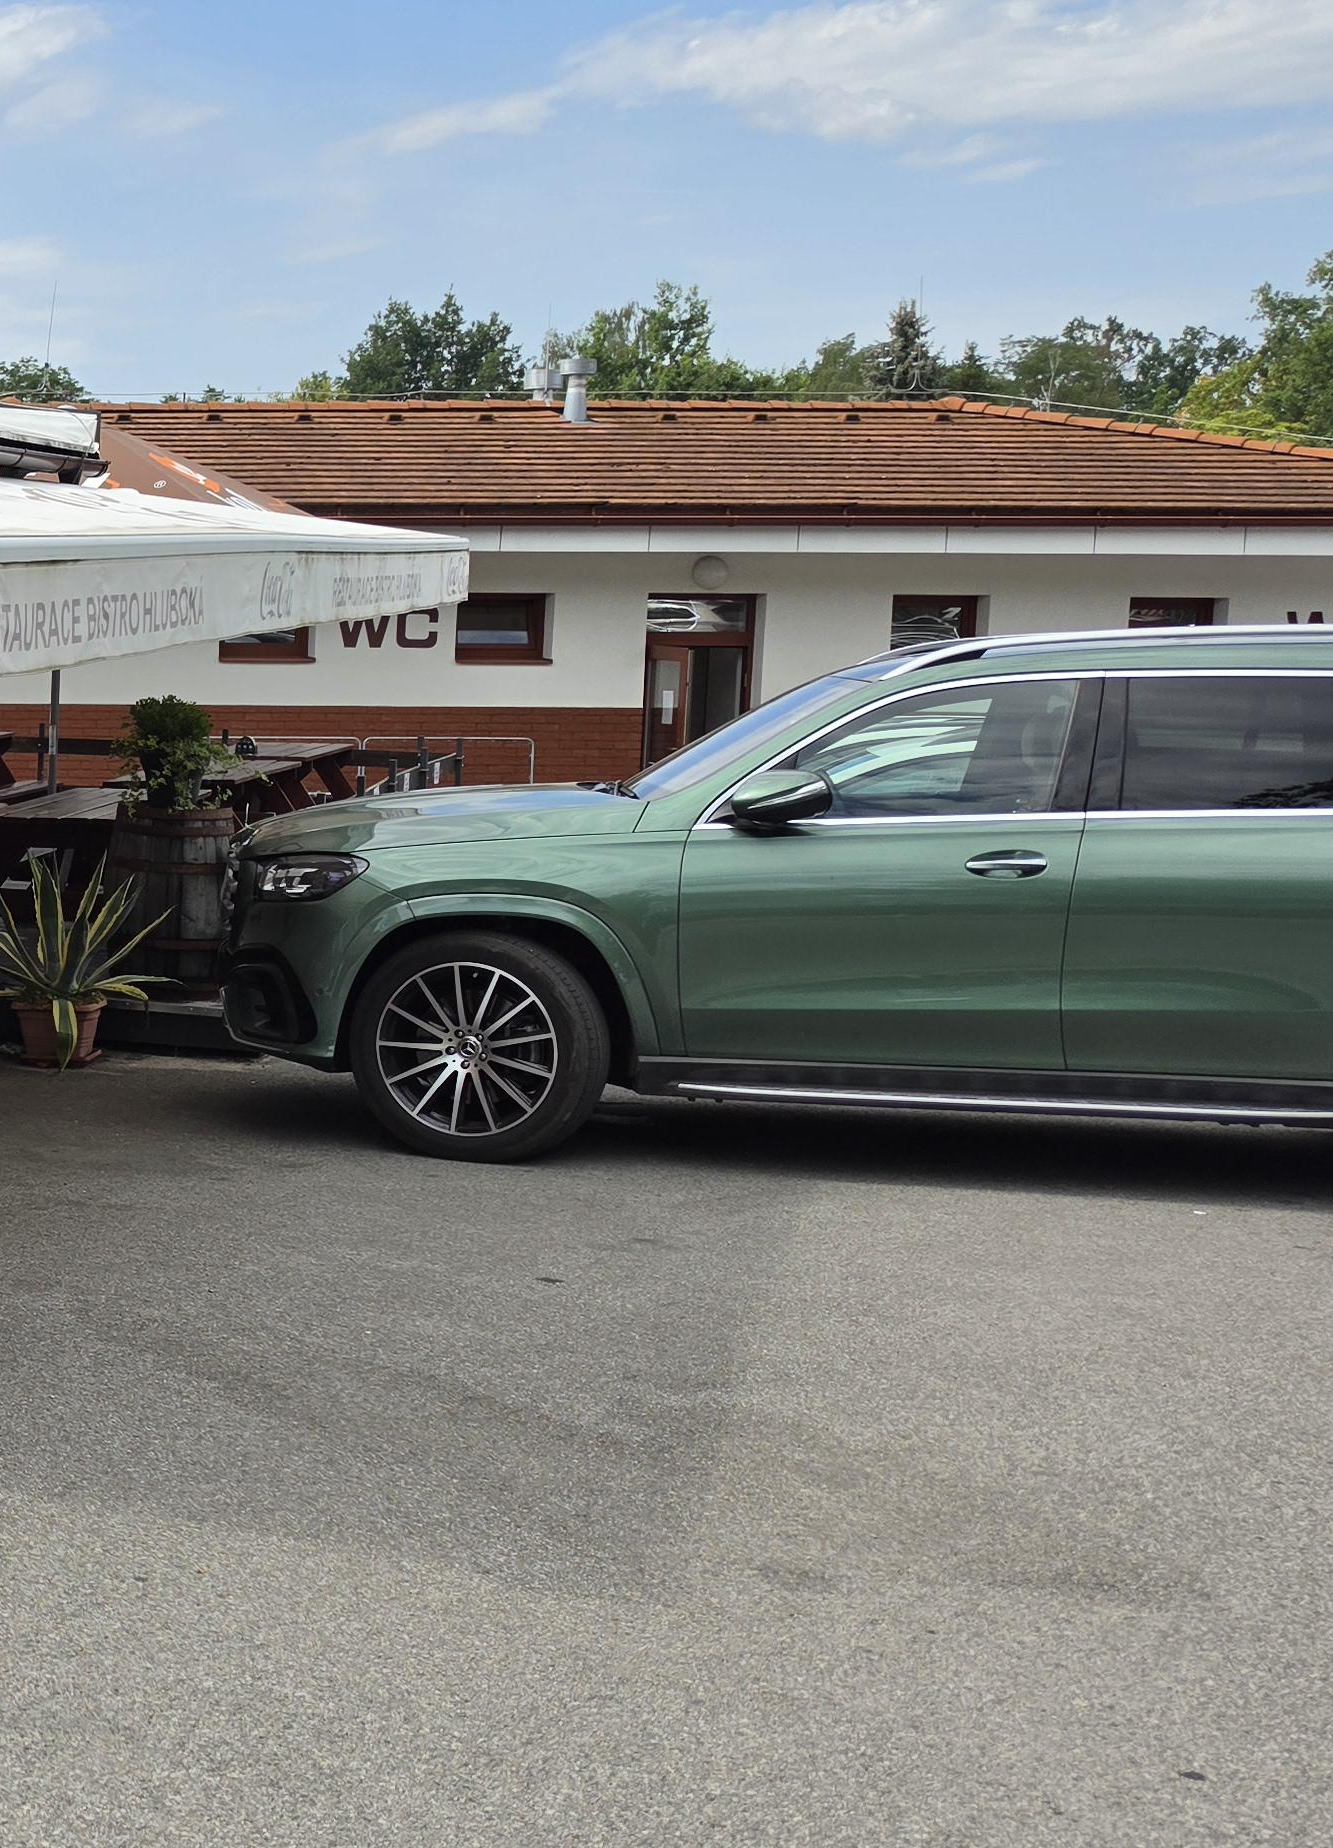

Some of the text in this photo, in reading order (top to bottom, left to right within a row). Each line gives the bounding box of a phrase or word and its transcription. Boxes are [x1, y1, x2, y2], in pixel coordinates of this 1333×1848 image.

[85, 590, 140, 641] BISTRO
[142, 576, 205, 635] HLUBOKÁ
[339, 607, 439, 648] WC
